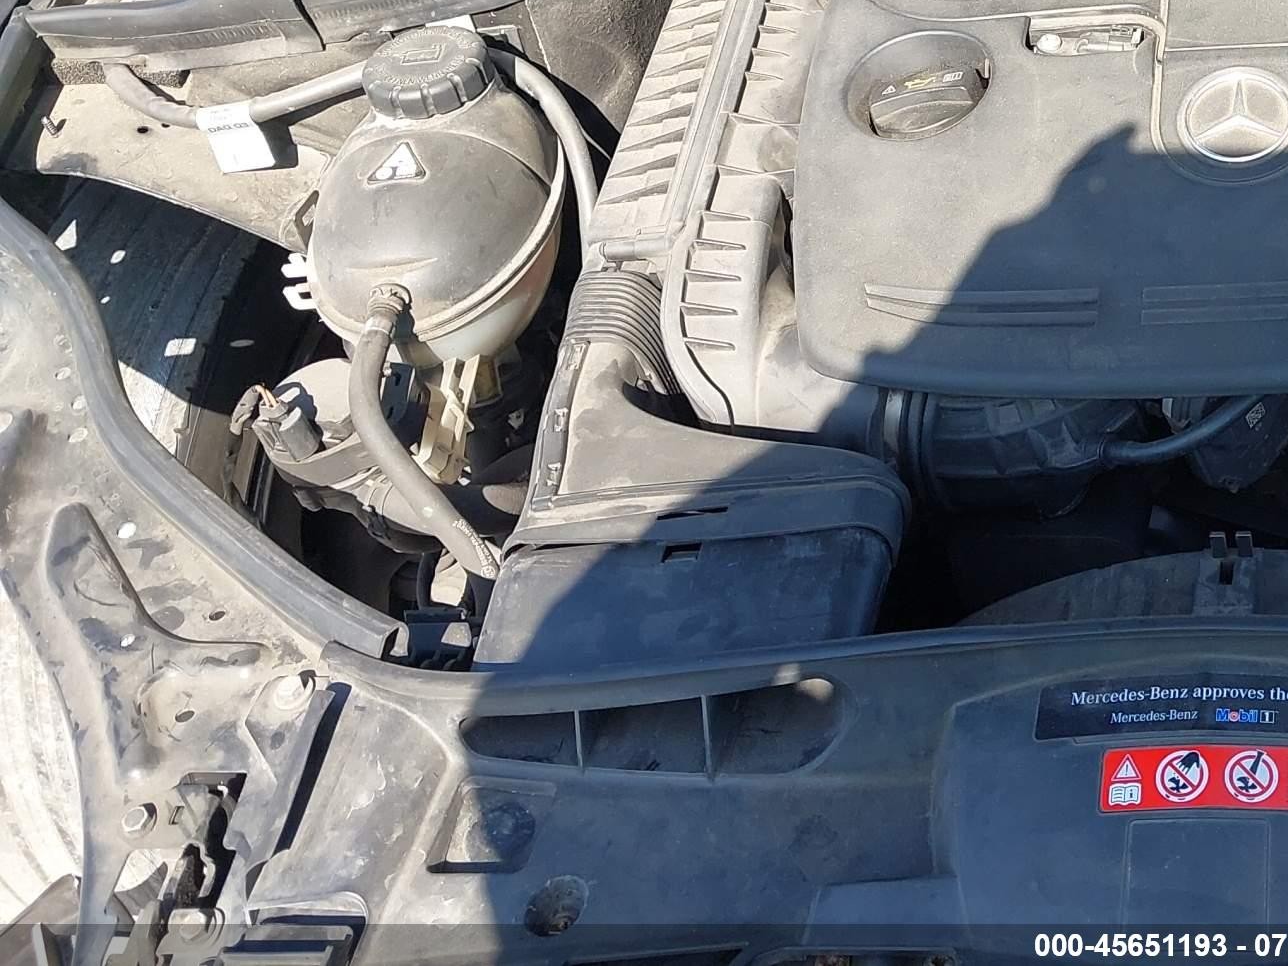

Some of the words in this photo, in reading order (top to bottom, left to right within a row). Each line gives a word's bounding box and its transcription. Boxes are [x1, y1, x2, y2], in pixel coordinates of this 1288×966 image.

[1071, 686, 1188, 705] Mercedes-Benz
[1193, 686, 1265, 701] approves
[1110, 709, 1199, 724] Mercedes-Benz
[1215, 708, 1258, 723] Mobil
